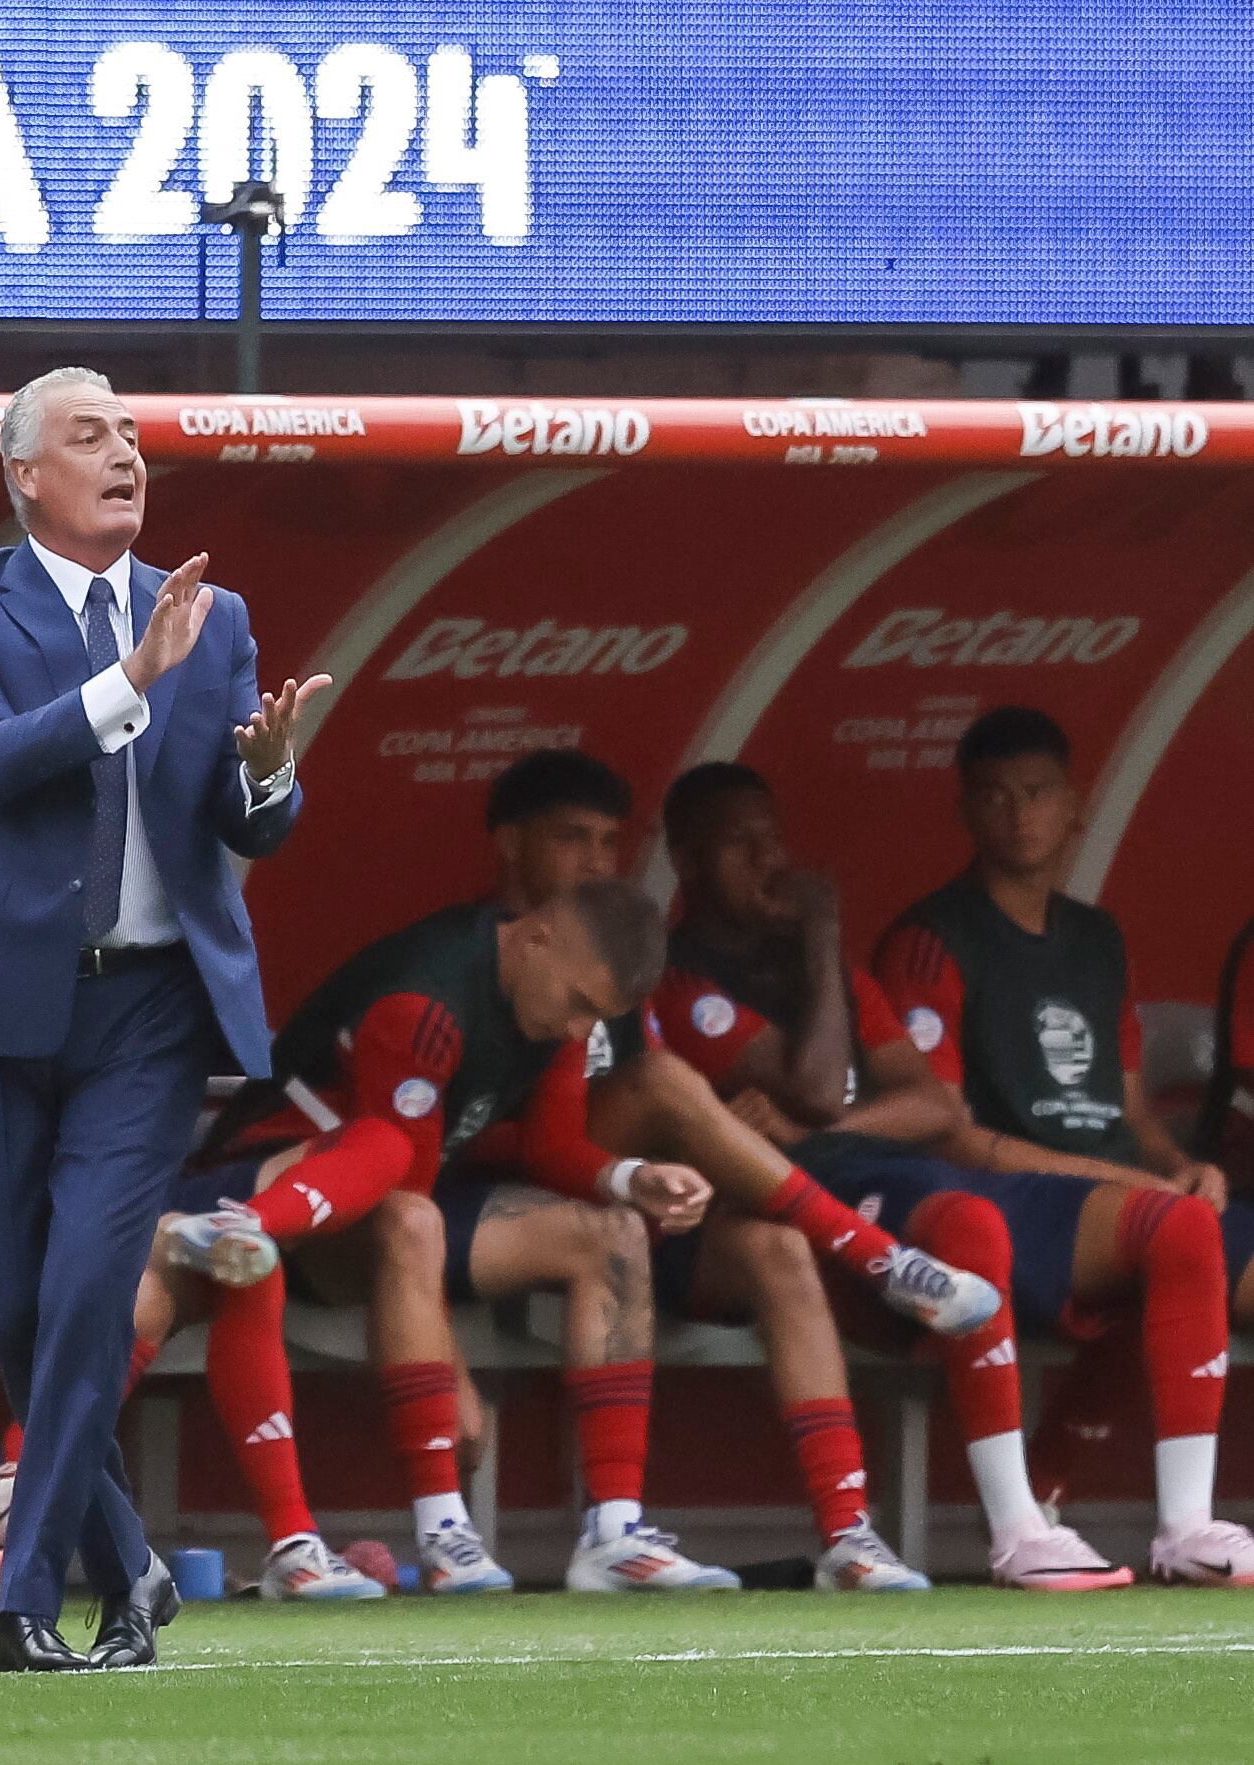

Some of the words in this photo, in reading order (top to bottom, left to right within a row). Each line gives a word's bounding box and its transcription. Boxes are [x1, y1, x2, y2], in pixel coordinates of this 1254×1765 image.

[91, 40, 531, 246] 2024
[178, 408, 248, 436] COPA
[250, 408, 366, 436] AMERICA
[455, 399, 650, 456] Betano
[742, 410, 809, 437] COPA
[812, 410, 926, 438] AMERICA
[1017, 402, 1208, 457] Betano
[381, 617, 688, 681] Betano
[841, 607, 1140, 670] Betano
